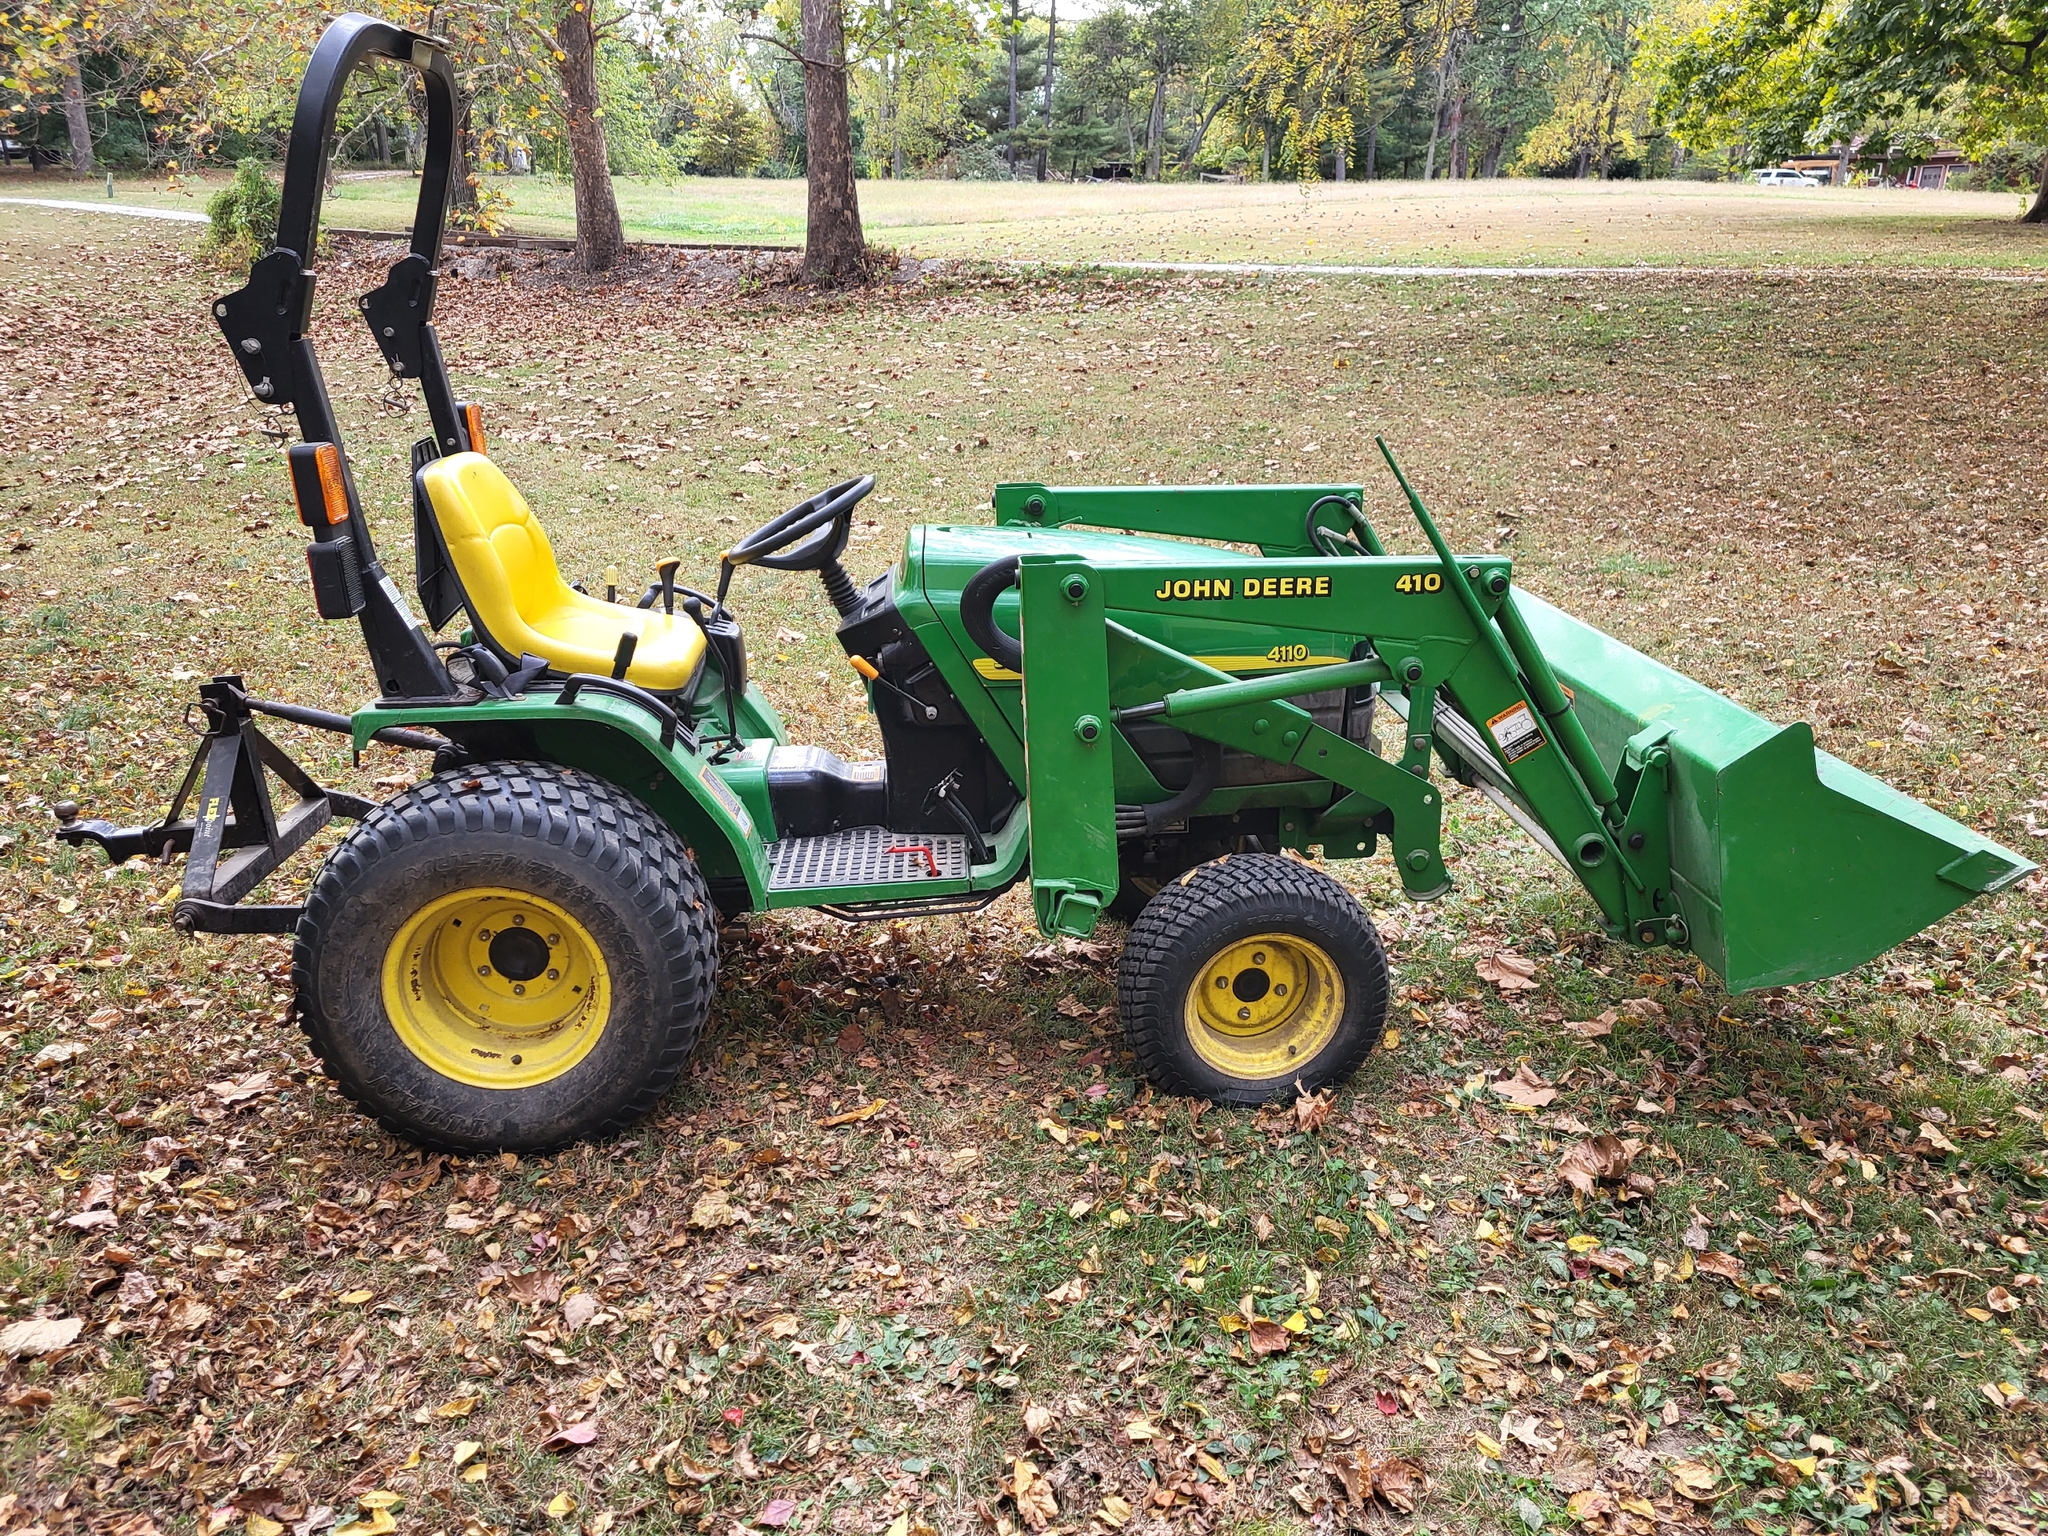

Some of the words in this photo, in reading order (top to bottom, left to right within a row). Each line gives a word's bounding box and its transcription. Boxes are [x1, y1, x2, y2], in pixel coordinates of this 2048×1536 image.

[1155, 578, 1234, 601] JOHN
[1242, 576, 1332, 599] DEERE
[1394, 573, 1444, 595] 410
[1266, 644, 1309, 662] 4110
[1498, 703, 1523, 721] WARNING
[402, 852, 518, 886] MULTI
